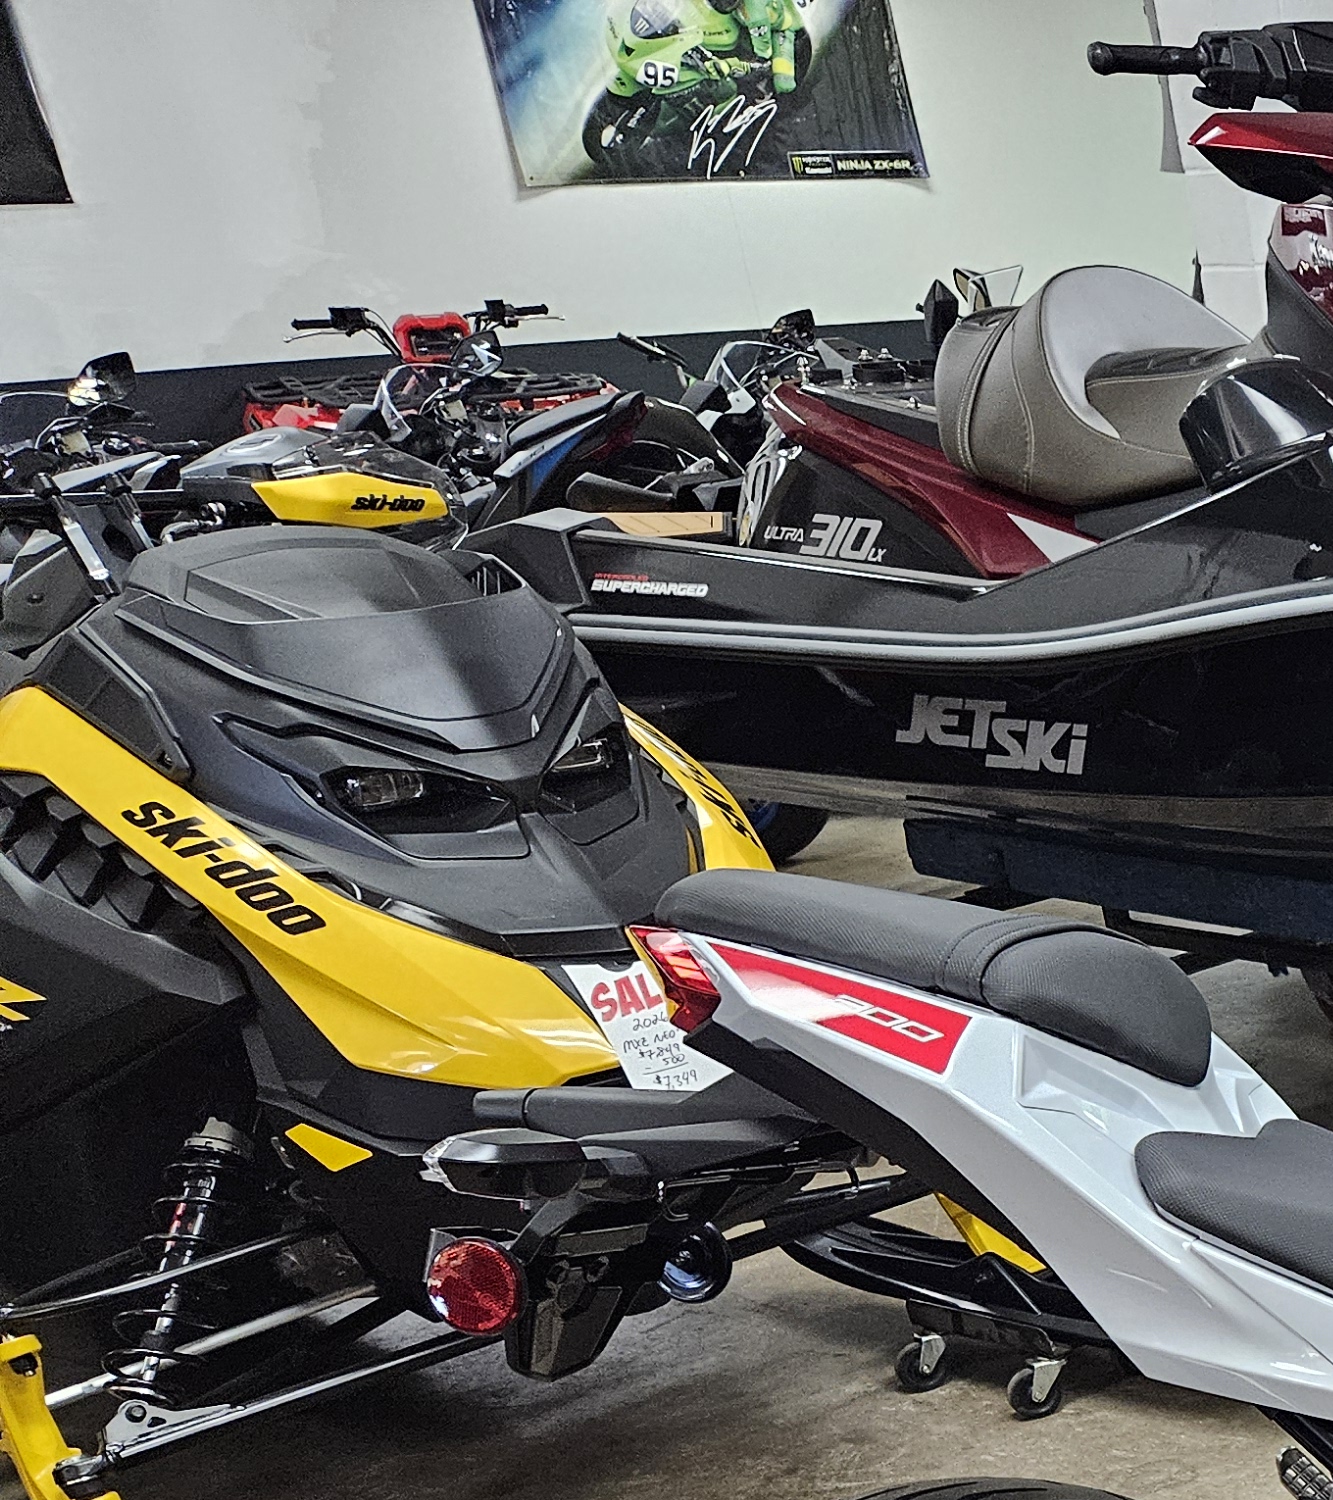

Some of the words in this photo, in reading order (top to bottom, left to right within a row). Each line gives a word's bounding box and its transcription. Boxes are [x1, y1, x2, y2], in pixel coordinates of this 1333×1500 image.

[643, 60, 677, 89] 95
[837, 160, 872, 171] NINJA
[763, 524, 804, 543] ULTRA
[799, 513, 883, 560] 310
[870, 548, 887, 563] LX
[590, 578, 710, 598] SUPERCHARGED
[121, 801, 327, 936] ski-doo
[591, 973, 663, 1023] SAL
